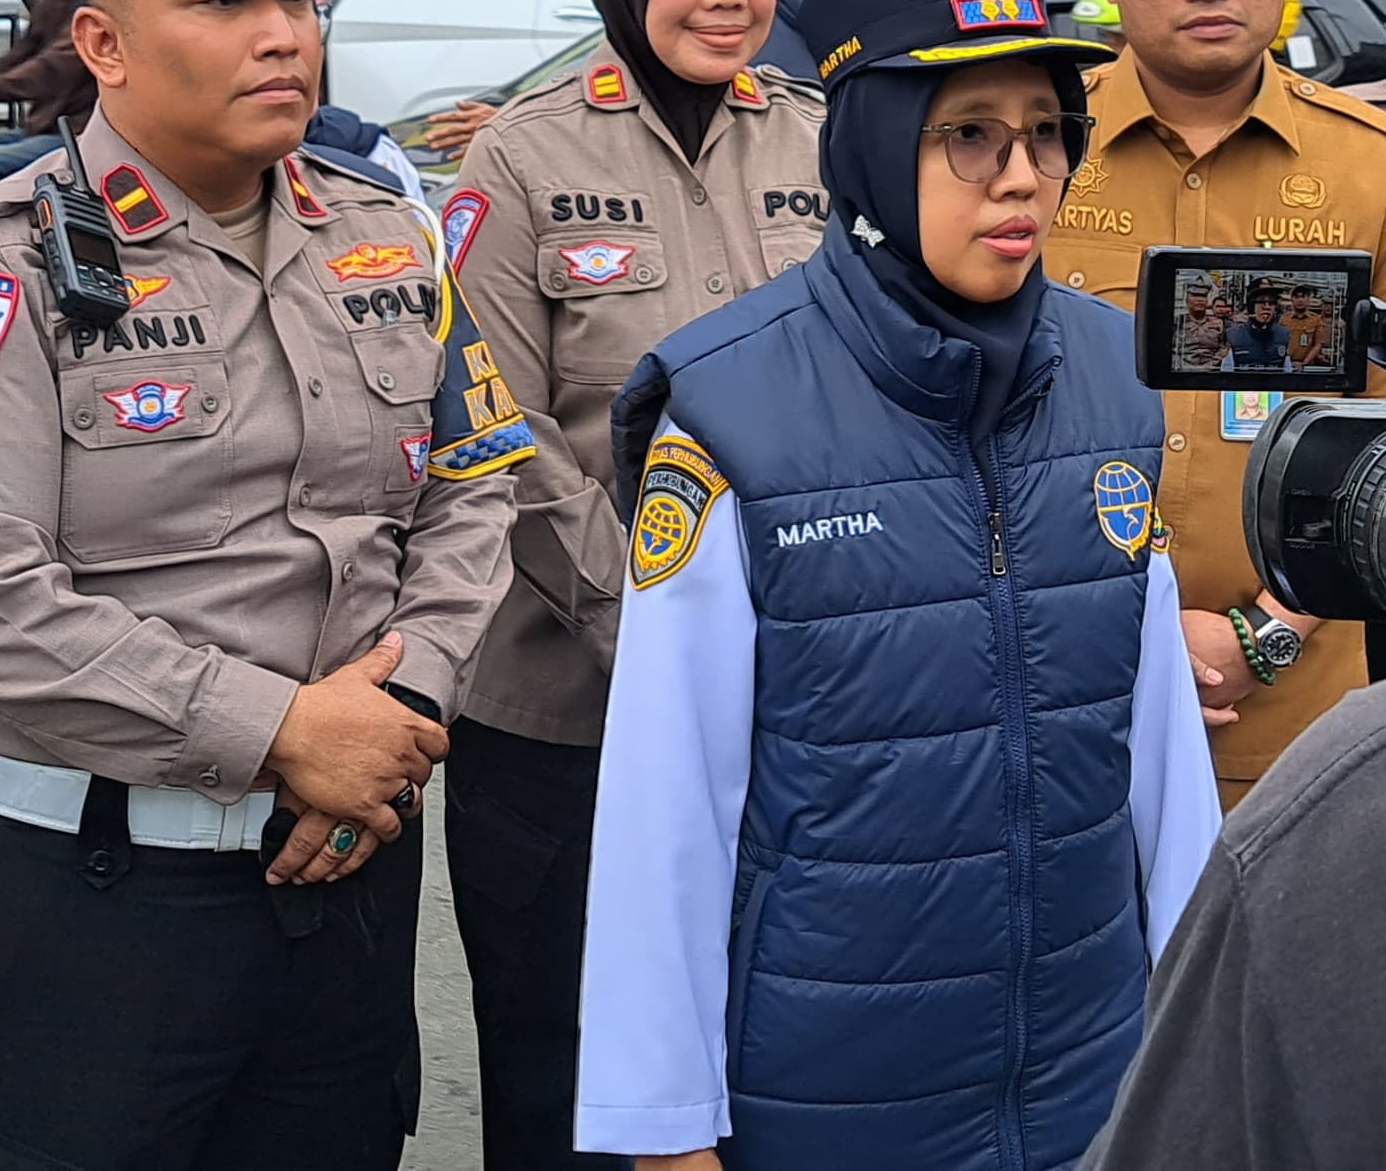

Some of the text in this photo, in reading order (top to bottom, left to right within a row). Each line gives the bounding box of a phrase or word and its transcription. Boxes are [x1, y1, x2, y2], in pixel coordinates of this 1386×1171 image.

[818, 34, 863, 80] MARTHA
[551, 193, 645, 223] SUSI
[1254, 215, 1346, 247] LURAH
[71, 314, 207, 360] PANJI
[776, 510, 884, 549] MARTHA
